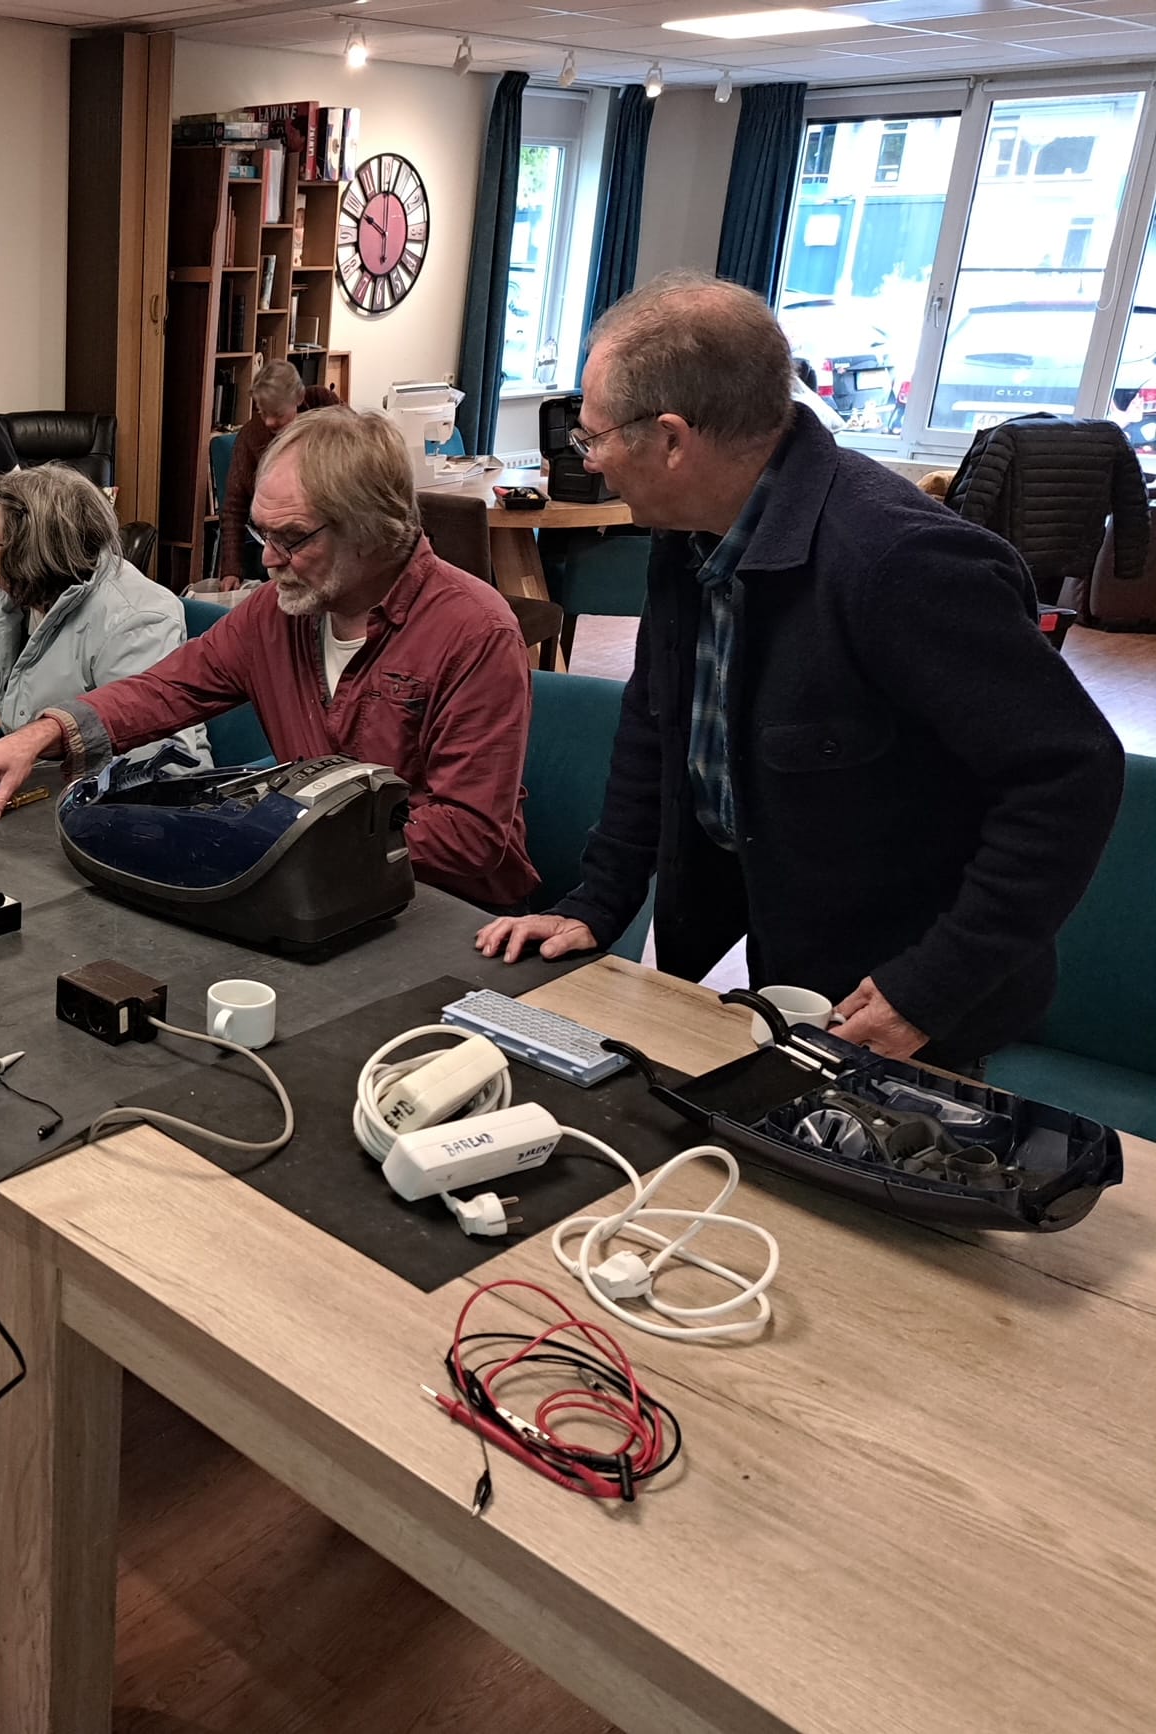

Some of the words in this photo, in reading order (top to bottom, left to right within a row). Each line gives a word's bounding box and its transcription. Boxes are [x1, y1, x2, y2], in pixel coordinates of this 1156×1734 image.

[258, 105, 298, 121] LAWINE
[308, 127, 316, 157] LAWINE
[996, 389, 1034, 397] CLIO
[383, 1100, 415, 1130] END
[442, 1133, 494, 1157] BAREND
